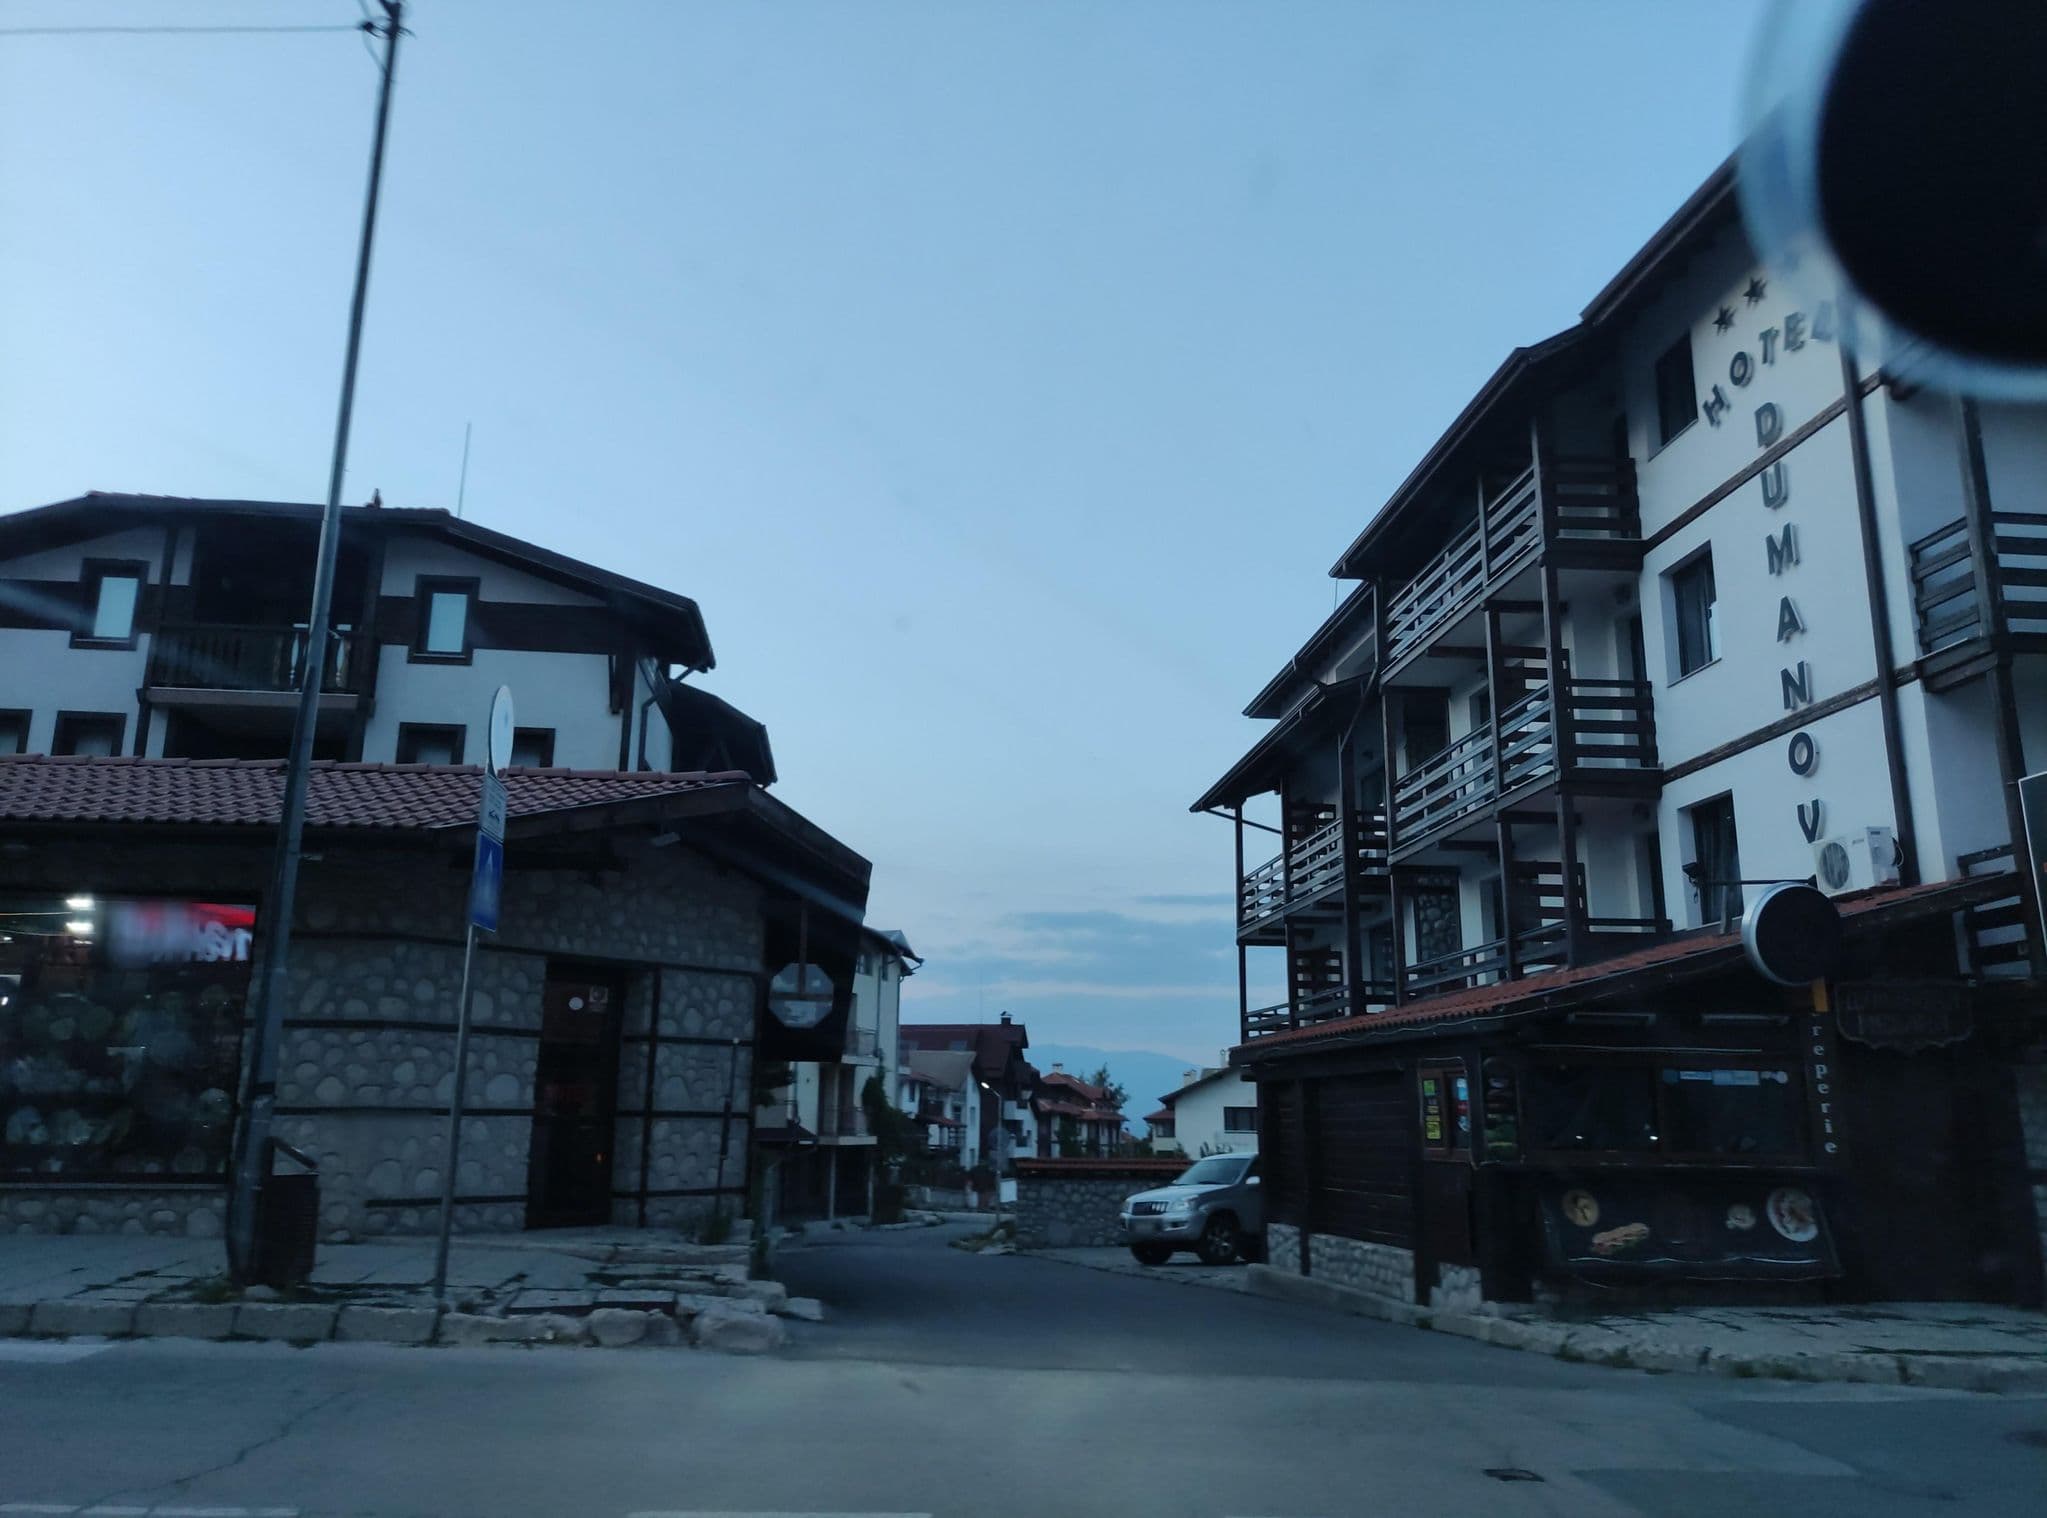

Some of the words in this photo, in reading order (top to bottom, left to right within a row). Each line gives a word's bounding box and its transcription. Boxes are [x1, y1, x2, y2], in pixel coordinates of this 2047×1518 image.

[1701, 301, 1836, 429] HOTEL
[1754, 402, 1826, 845] DUMANOV
[1810, 1012, 1838, 1154] reperie
